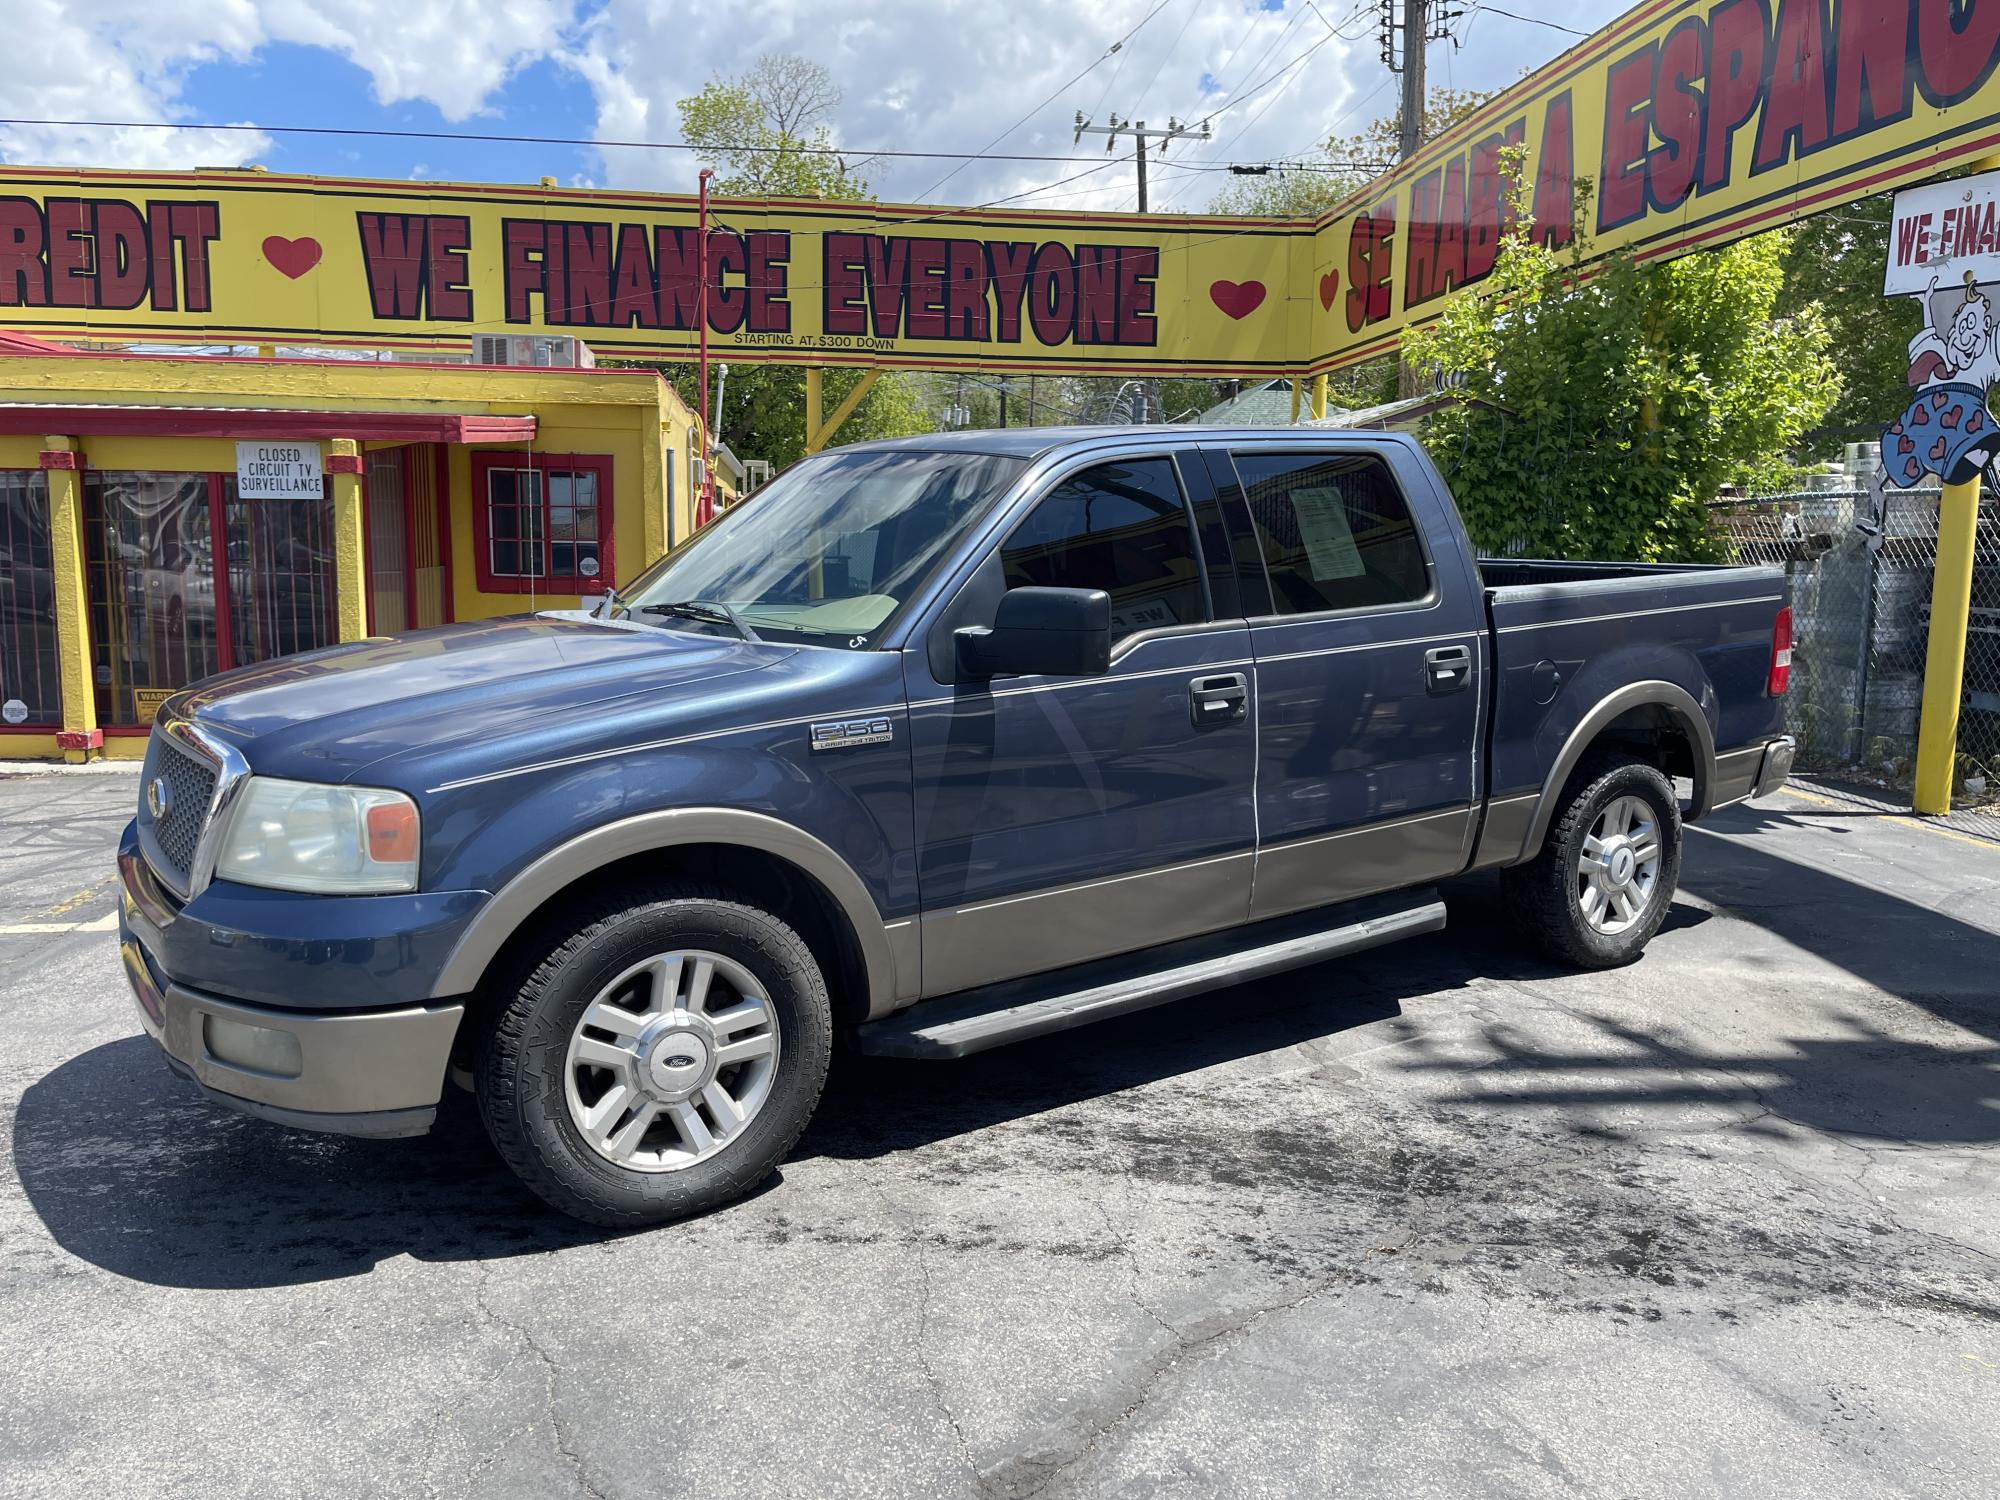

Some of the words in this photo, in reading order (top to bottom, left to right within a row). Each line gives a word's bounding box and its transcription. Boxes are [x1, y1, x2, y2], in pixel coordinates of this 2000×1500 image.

[1897, 213, 1932, 267] WE
[1940, 201, 2000, 258] FINA
[1346, 194, 1397, 334] SE
[356, 211, 474, 322] WE
[502, 217, 791, 334] FINANCE
[822, 231, 1159, 347] EVERYONE
[734, 333, 794, 344] STARTING
[857, 337, 894, 349] DOWN
[258, 448, 300, 462] CLOSED
[248, 463, 290, 477] CIRCUIT
[298, 464, 312, 477] TV
[241, 477, 321, 492] SURVEILLANCE
